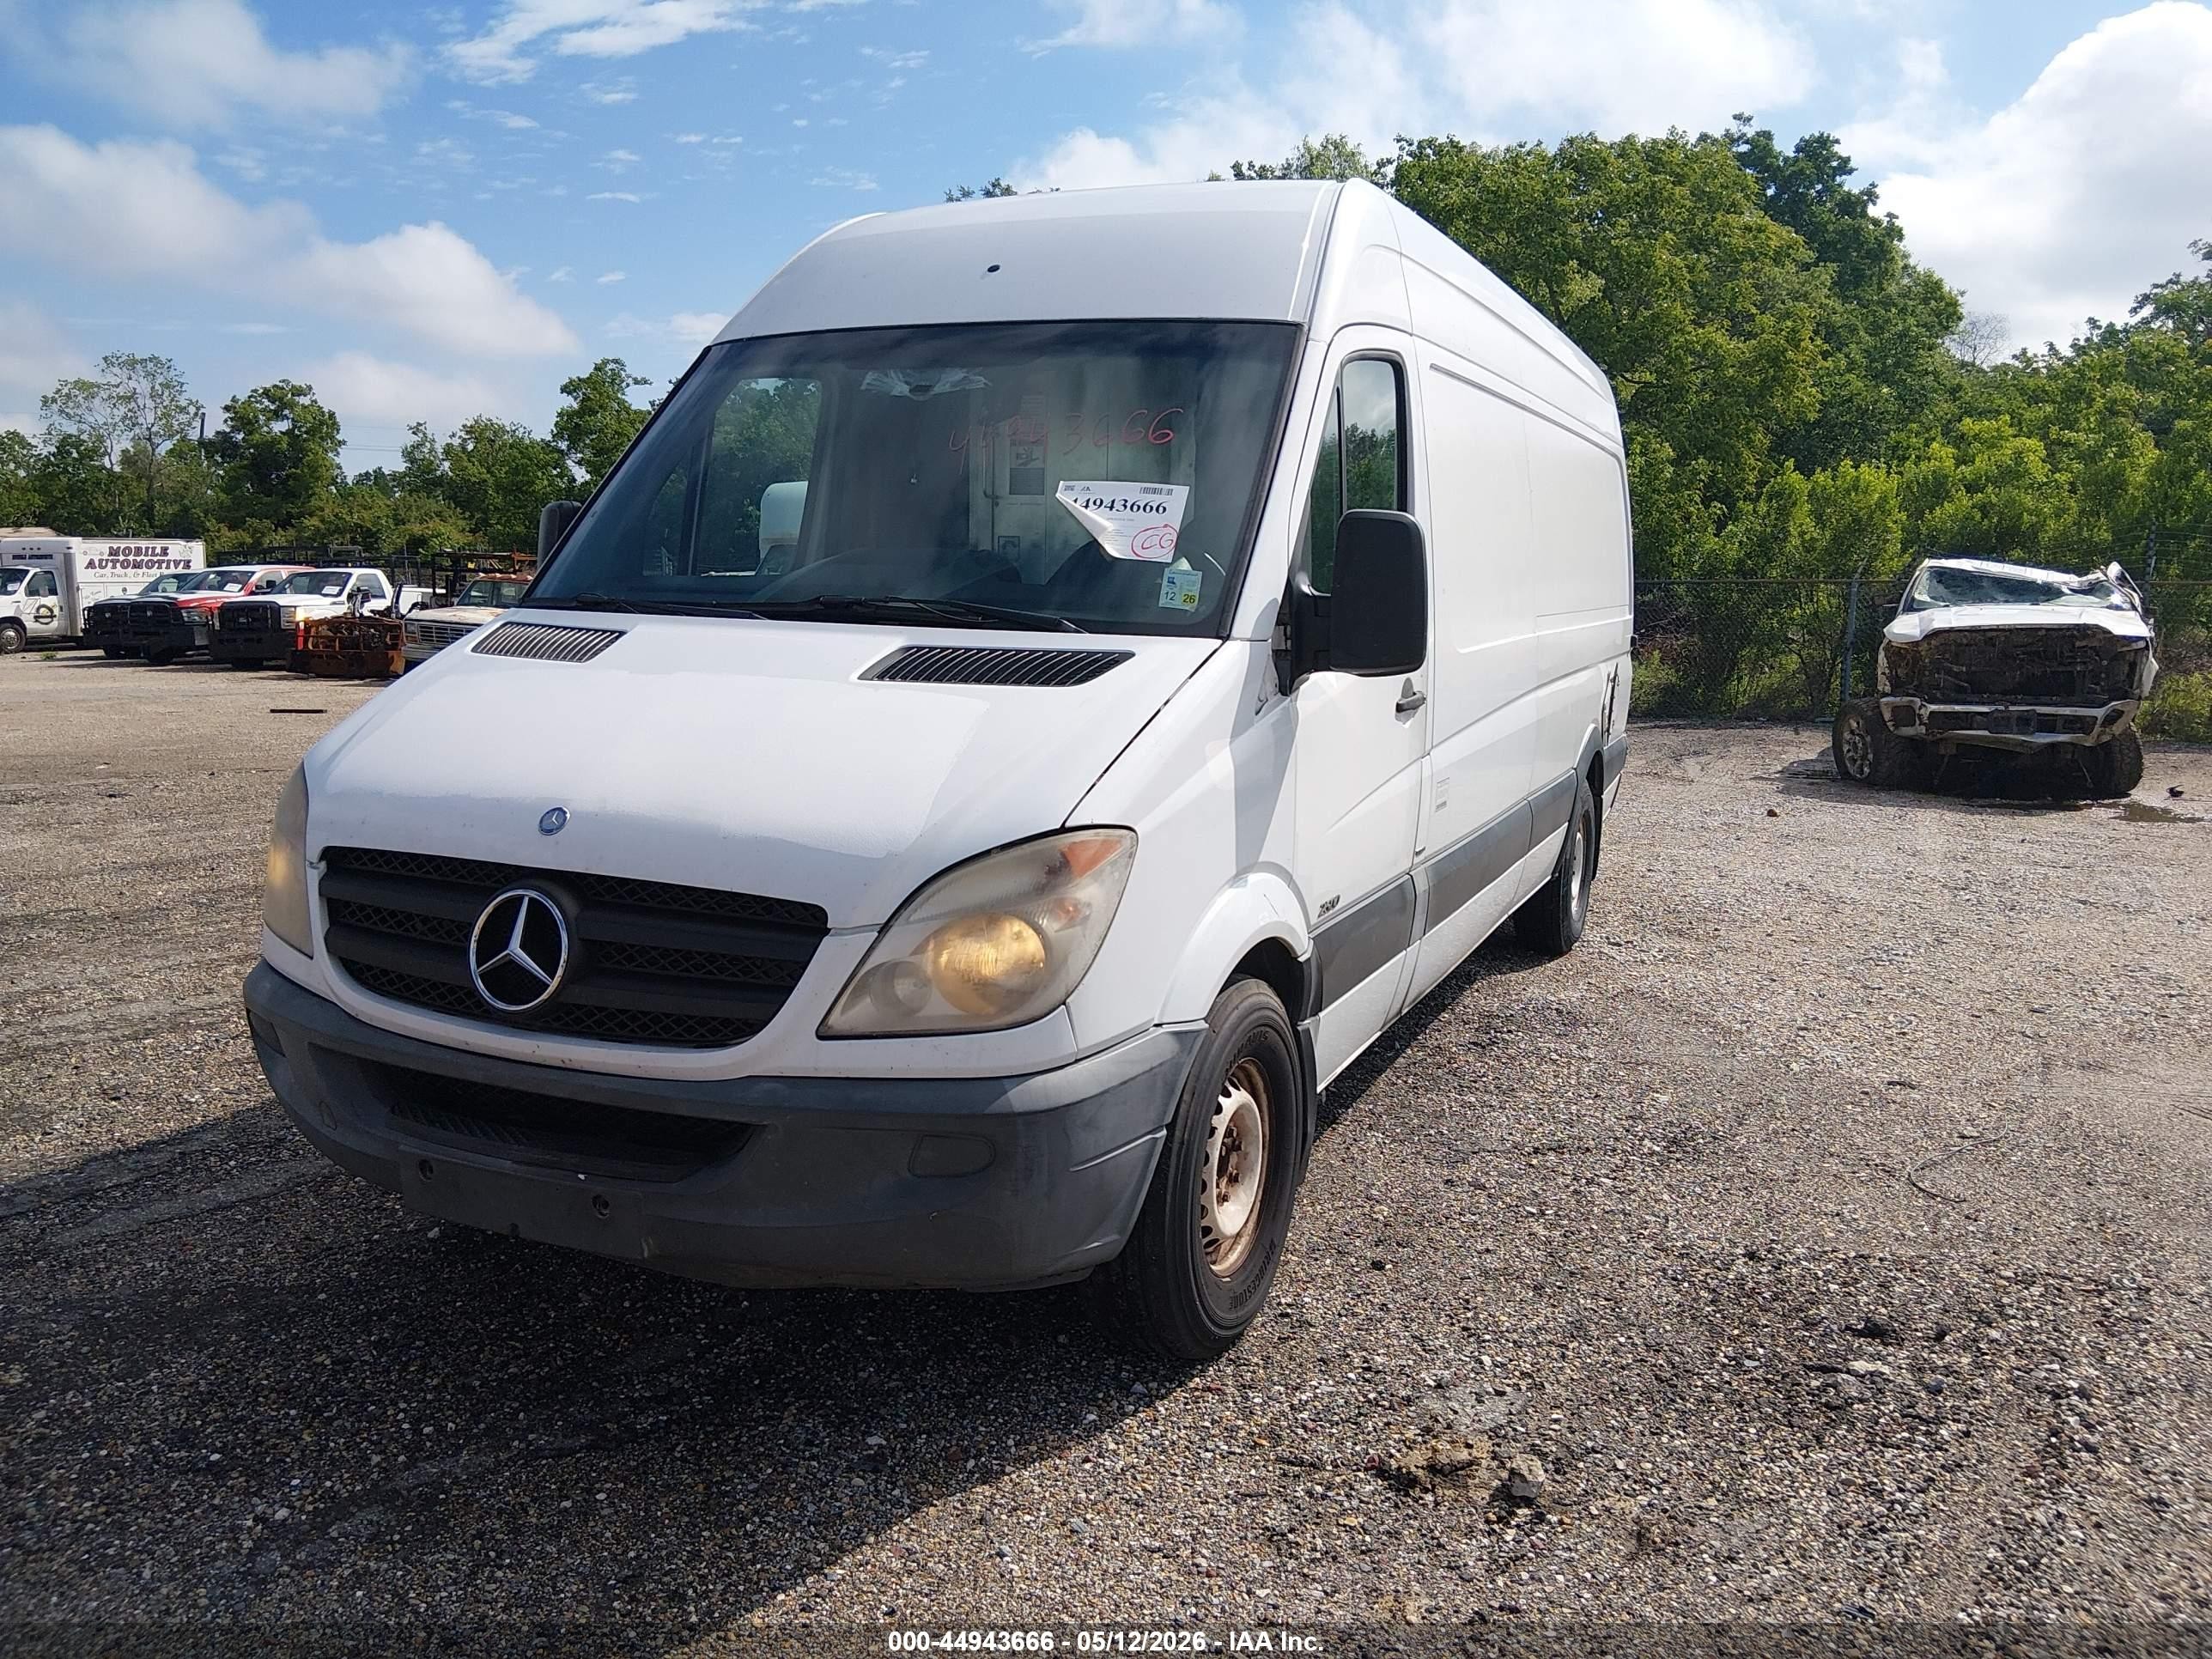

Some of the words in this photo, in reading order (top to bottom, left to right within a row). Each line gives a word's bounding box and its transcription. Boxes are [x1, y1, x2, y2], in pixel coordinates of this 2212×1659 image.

[107, 546, 169, 557] MOBILE
[85, 559, 192, 570] AUTOMOTIVE
[1164, 591, 1176, 601] 12
[1182, 593, 1195, 604] 26
